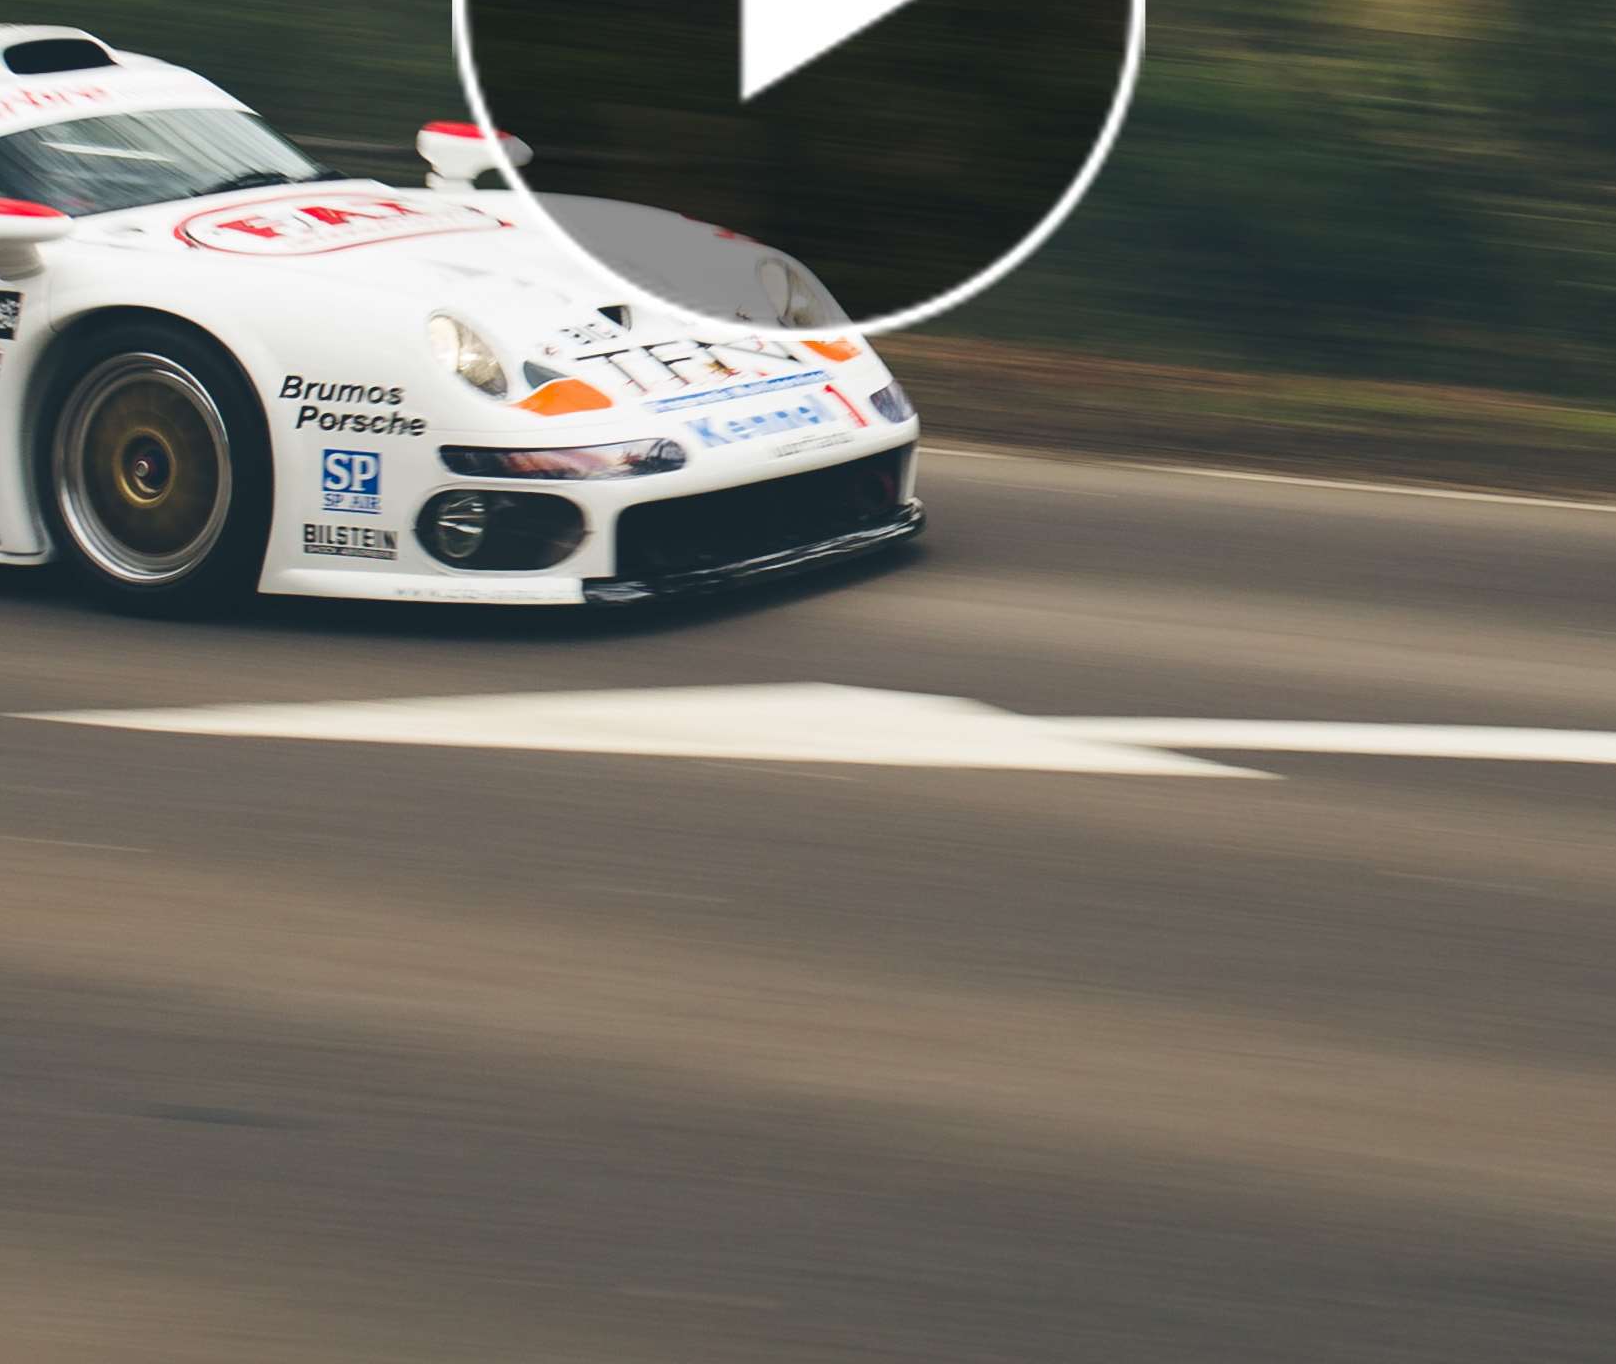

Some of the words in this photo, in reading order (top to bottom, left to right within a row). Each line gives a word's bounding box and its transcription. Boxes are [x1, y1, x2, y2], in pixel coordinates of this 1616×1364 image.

[279, 375, 405, 405] Brumos
[295, 405, 427, 436] Porsche
[324, 452, 378, 492] SP
[323, 493, 344, 507] SP
[303, 523, 399, 550] BILSTEIN
